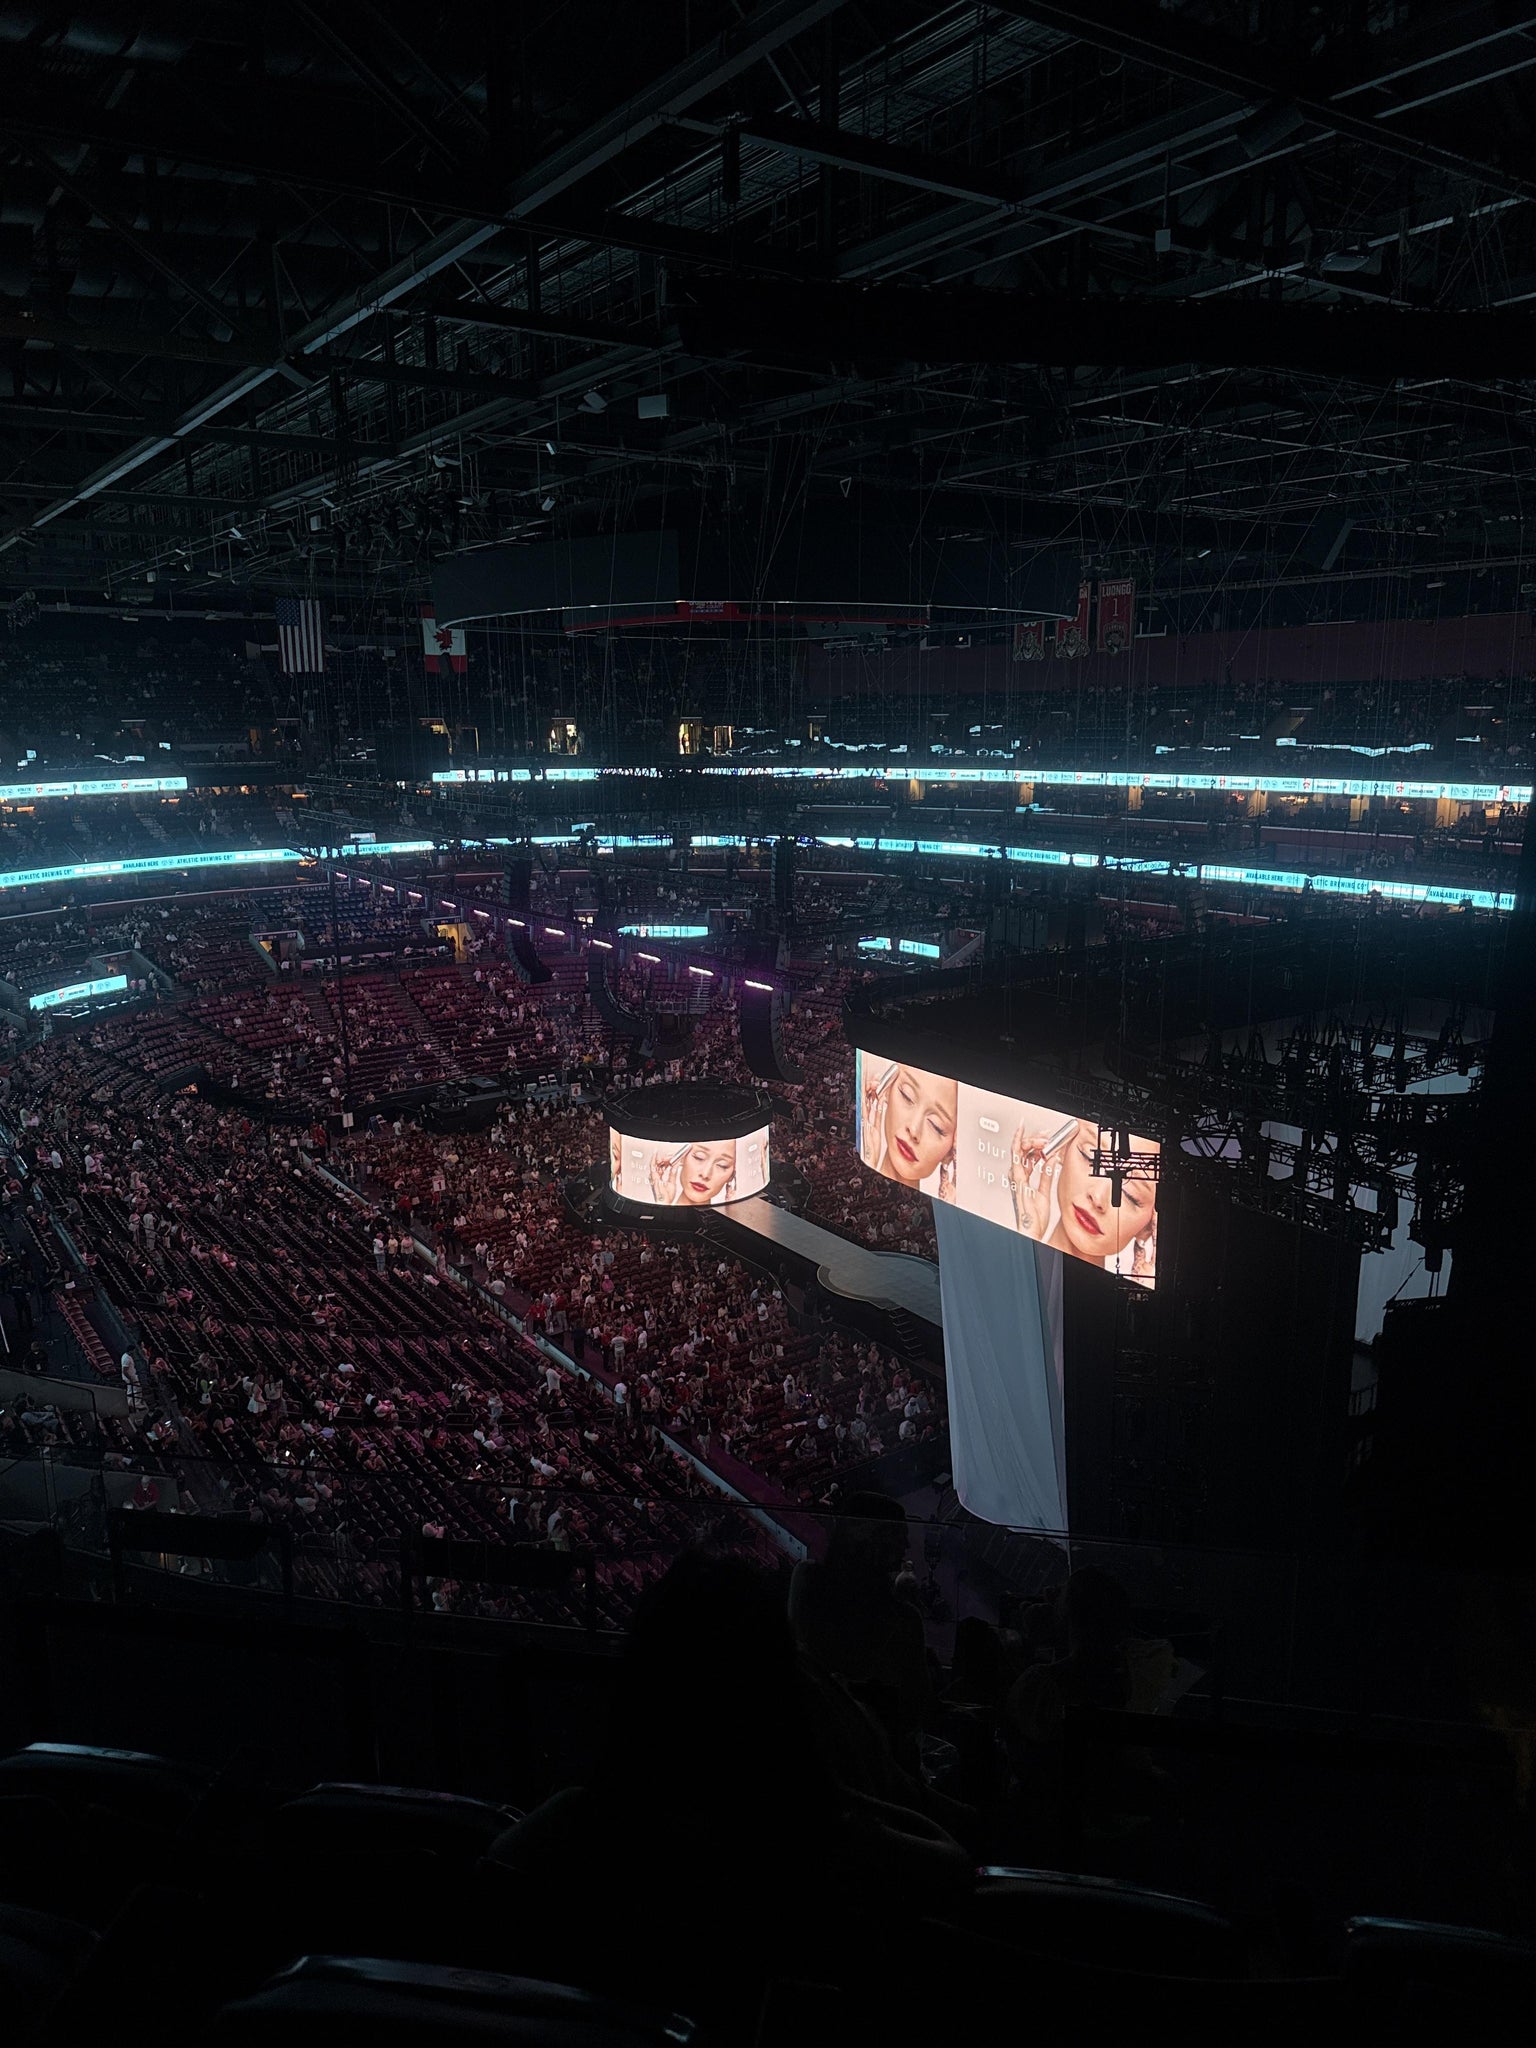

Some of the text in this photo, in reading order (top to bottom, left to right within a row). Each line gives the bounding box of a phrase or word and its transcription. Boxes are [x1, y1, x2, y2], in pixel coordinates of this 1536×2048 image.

[1102, 583, 1131, 597] LUONGO
[18, 872, 40, 881] ATHLETIC
[41, 870, 63, 878] BREWING
[1246, 872, 1270, 881] AVAILABLE
[1271, 874, 1283, 882] HERE
[1330, 880, 1355, 889] BREWING
[1429, 890, 1459, 900] AVAILABLE
[978, 1138, 1059, 1176] blur butter
[977, 1165, 1036, 1199] lip balm
